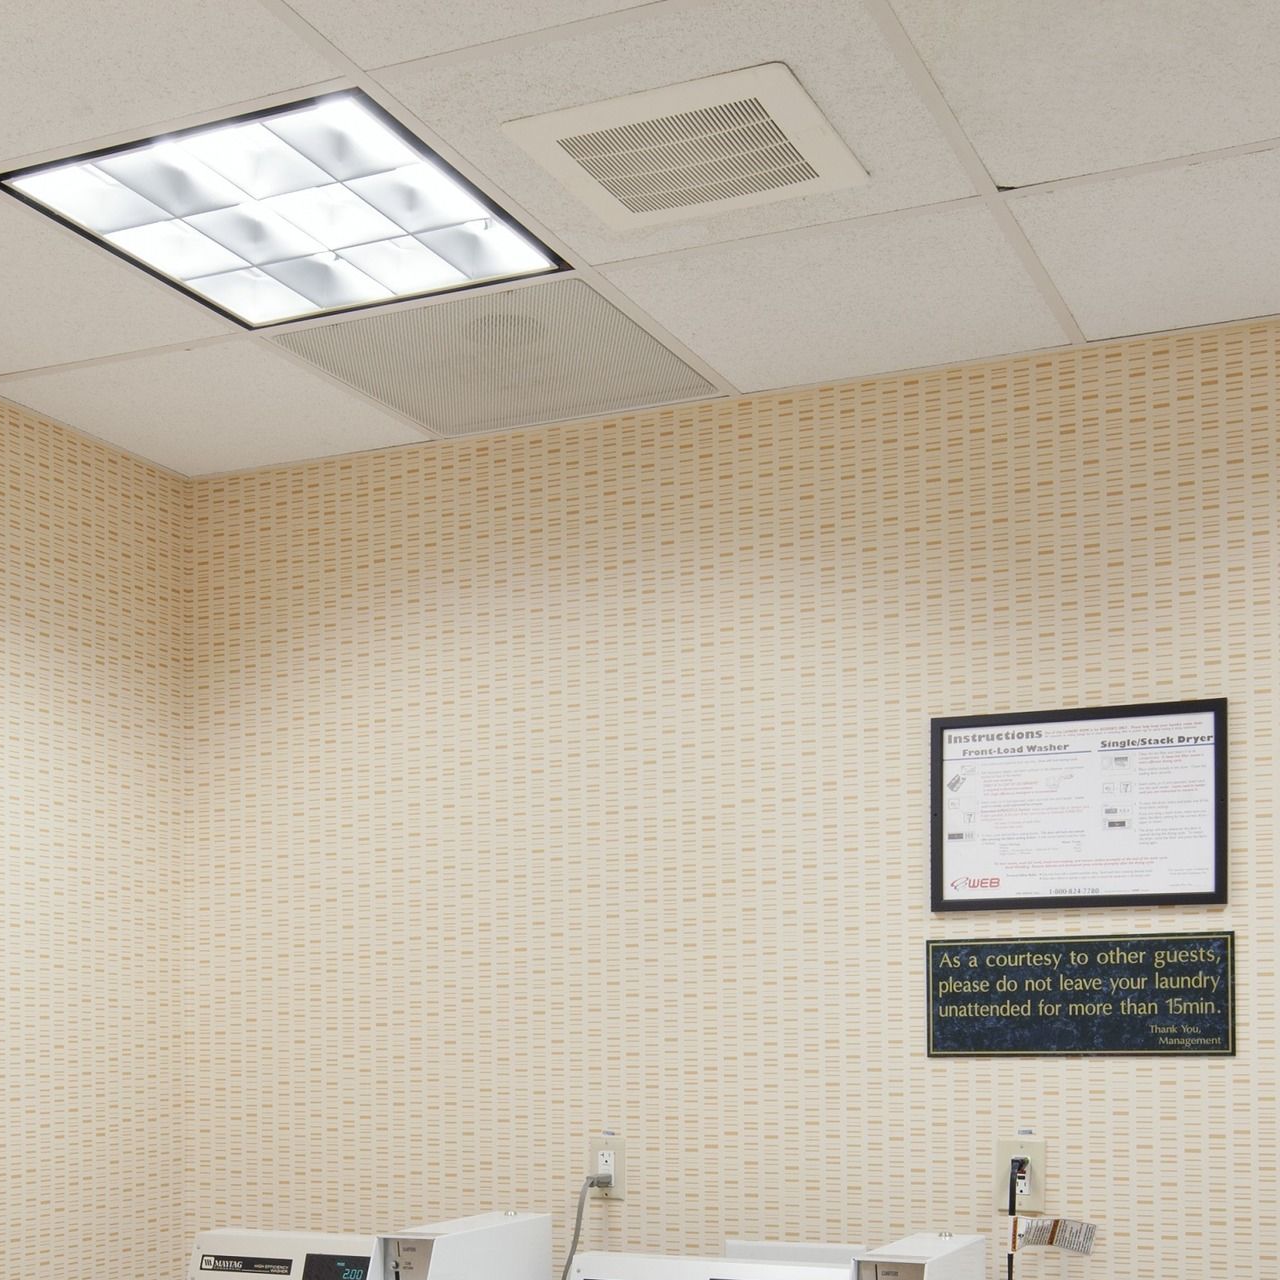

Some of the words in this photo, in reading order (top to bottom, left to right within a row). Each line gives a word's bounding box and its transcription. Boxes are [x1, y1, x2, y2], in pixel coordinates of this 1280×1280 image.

[948, 730, 1042, 744] Instructions
[1101, 736, 1174, 749] Single/Stack
[1177, 735, 1213, 745] Dryer
[962, 745, 1023, 756] Front-Load
[1026, 744, 1069, 753] Washer
[968, 877, 1000, 888] WEB
[939, 952, 961, 969] As
[969, 956, 978, 967] a
[986, 951, 1062, 970] courtesy
[1070, 951, 1088, 966] to
[1097, 947, 1146, 965] other
[1154, 947, 1221, 970] guests,
[939, 977, 989, 997] please
[996, 976, 1017, 993] do
[1024, 977, 1052, 992] not
[1059, 974, 1102, 991] leave
[1110, 976, 1148, 994] your
[1155, 972, 1220, 993] laundry
[939, 1000, 1030, 1017] unattended
[1038, 1000, 1061, 1016] for
[1069, 1002, 1112, 1016] more
[1120, 998, 1158, 1014] than
[1166, 997, 1221, 1014] 15min.
[1149, 1024, 1177, 1034] Thank
[1181, 1024, 1201, 1035] You,
[1158, 1035, 1221, 1048] Management
[215, 1259, 243, 1269] MAYTAG
[343, 1269, 364, 1280] 2.00
